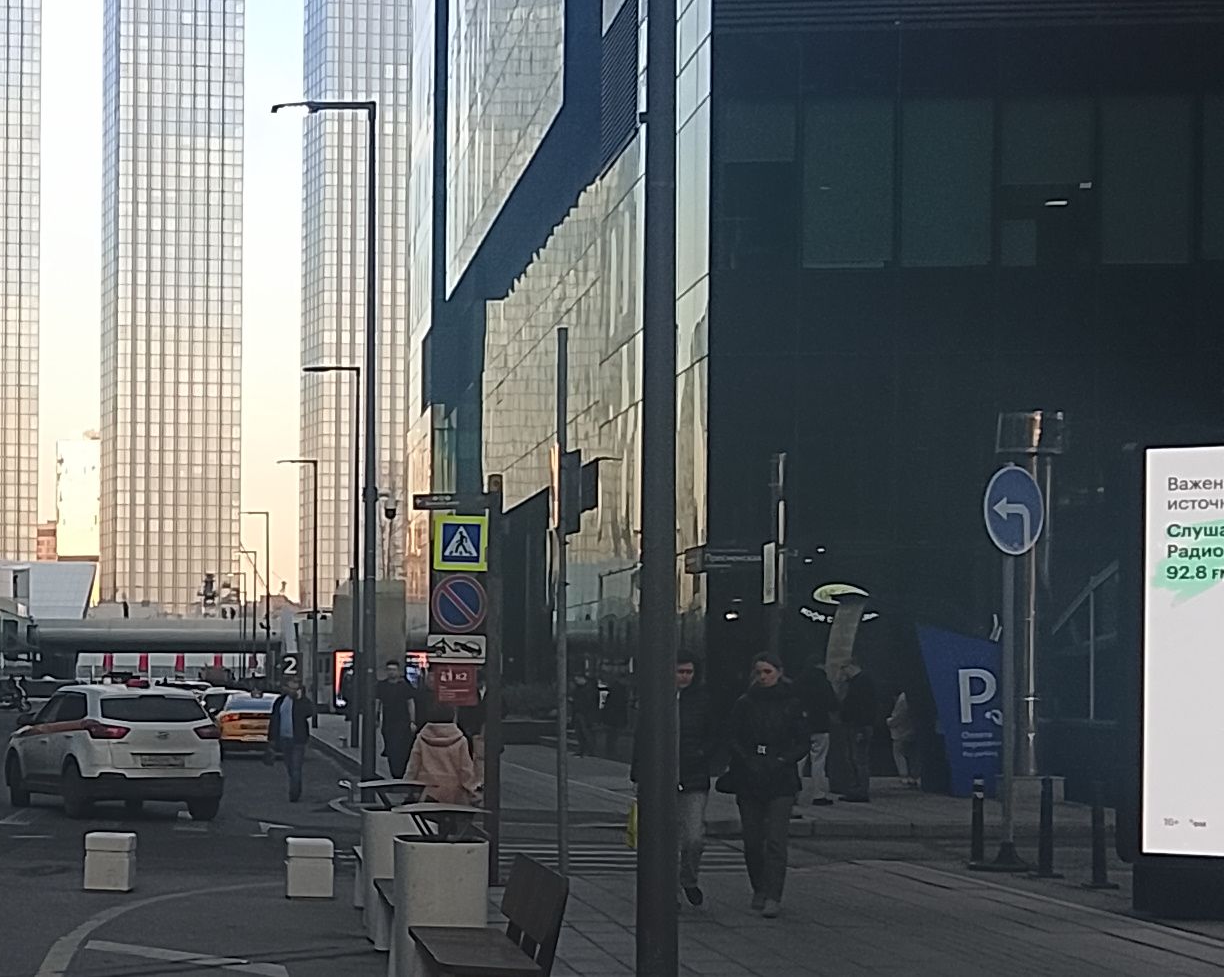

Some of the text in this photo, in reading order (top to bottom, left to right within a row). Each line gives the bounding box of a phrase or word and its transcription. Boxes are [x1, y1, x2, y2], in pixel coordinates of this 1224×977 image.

[1166, 565, 1207, 580] 92.8
[283, 656, 298, 675] 2
[958, 668, 997, 724] P
